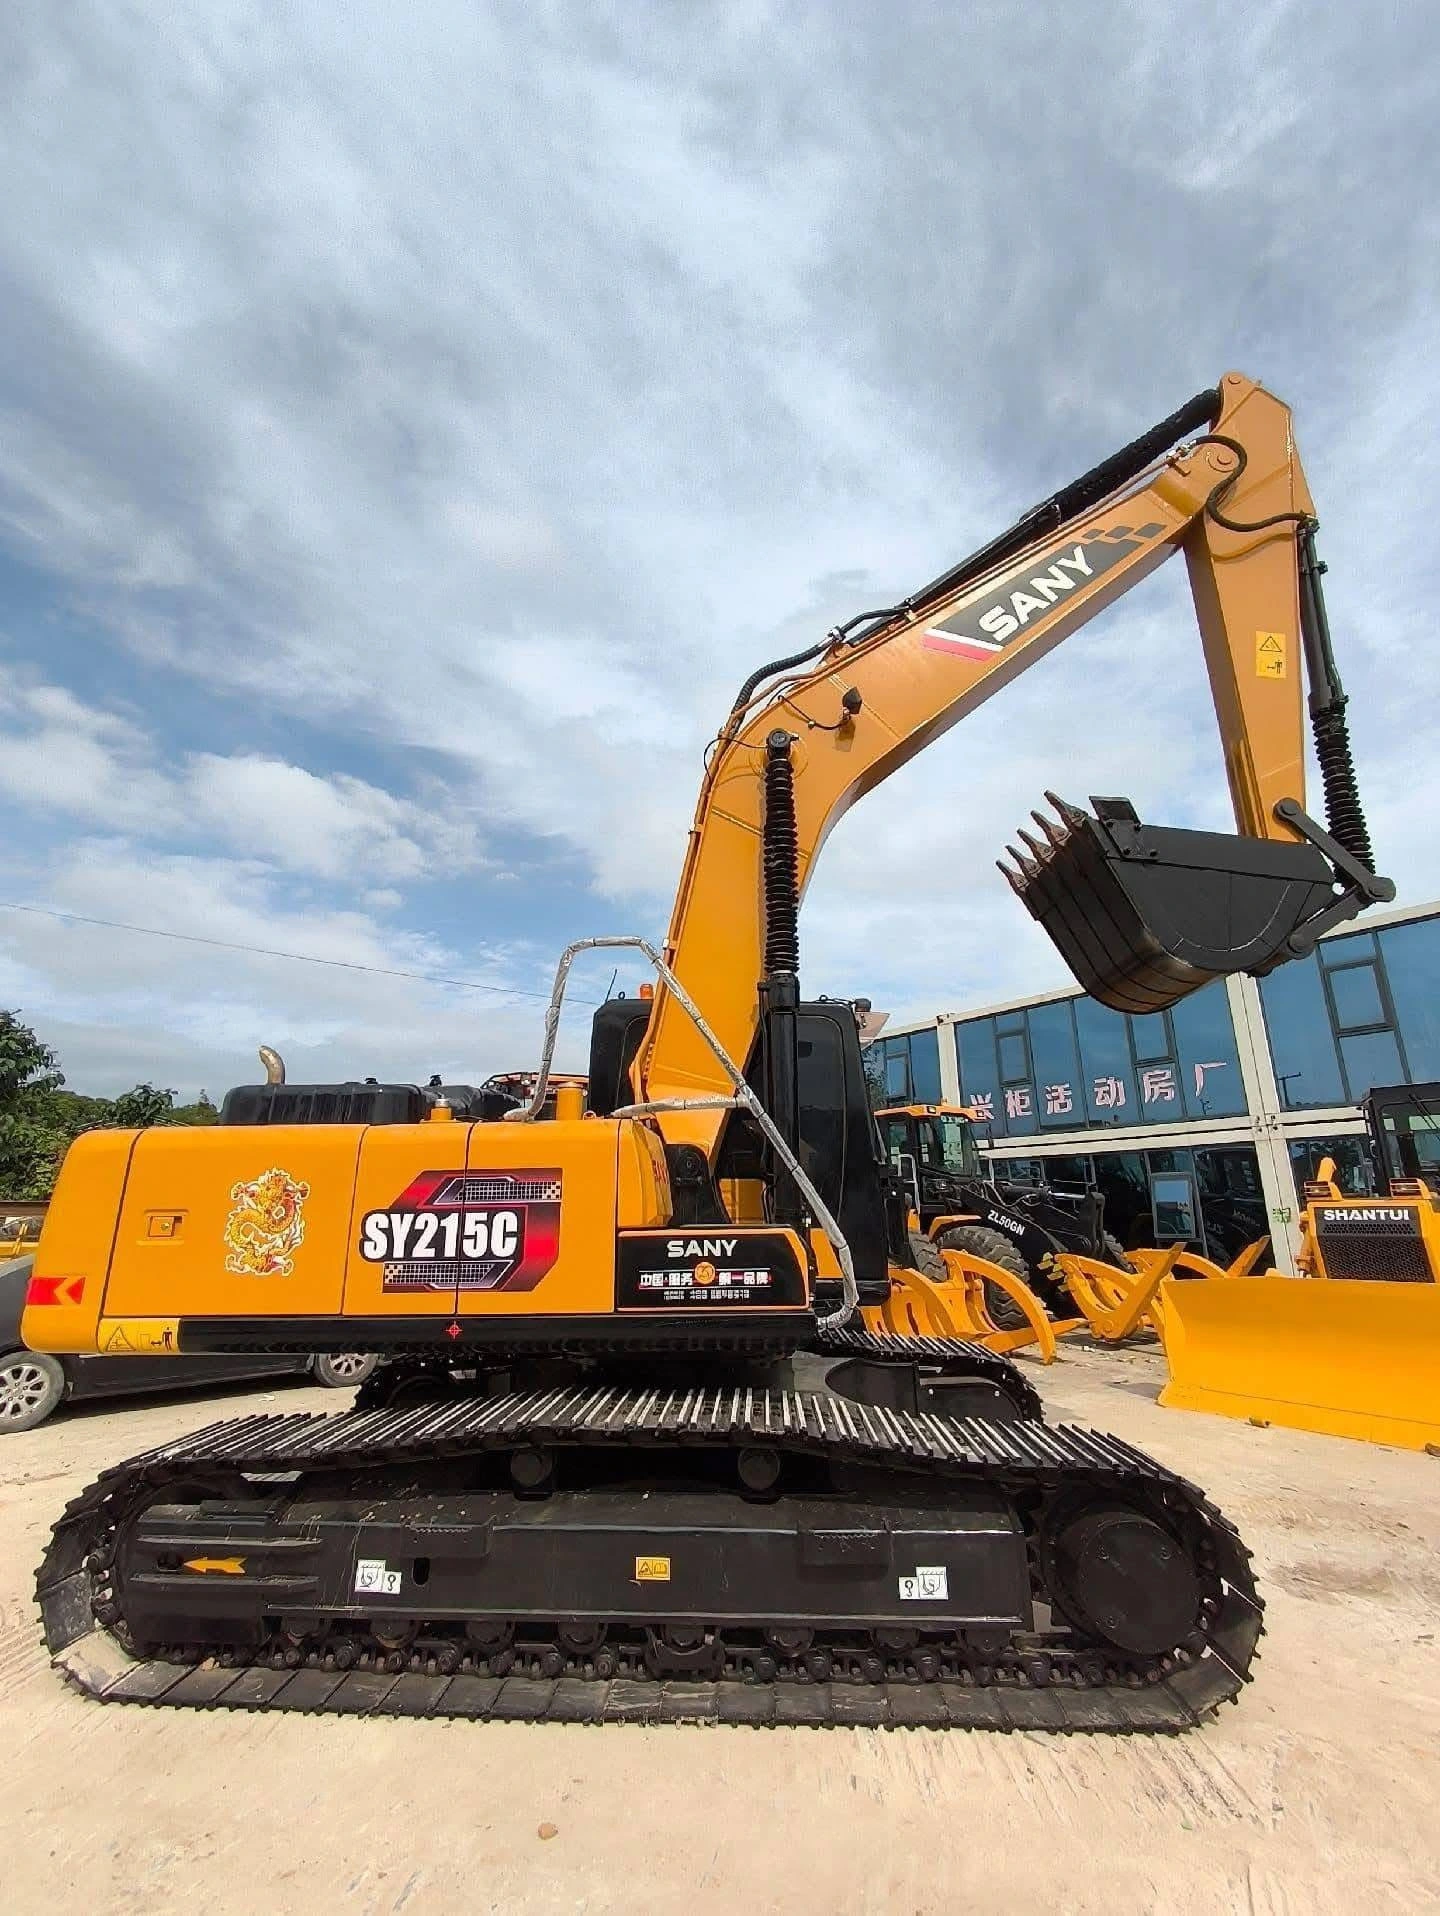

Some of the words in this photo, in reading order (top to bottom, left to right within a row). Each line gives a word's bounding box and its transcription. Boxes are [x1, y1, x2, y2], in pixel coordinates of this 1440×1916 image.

[979, 546, 1094, 641] SANY
[987, 1210, 1026, 1236] ZL50GN
[1323, 1209, 1411, 1221] SHANTUI
[363, 1211, 519, 1259] SY215C
[666, 1239, 739, 1258] SANY
